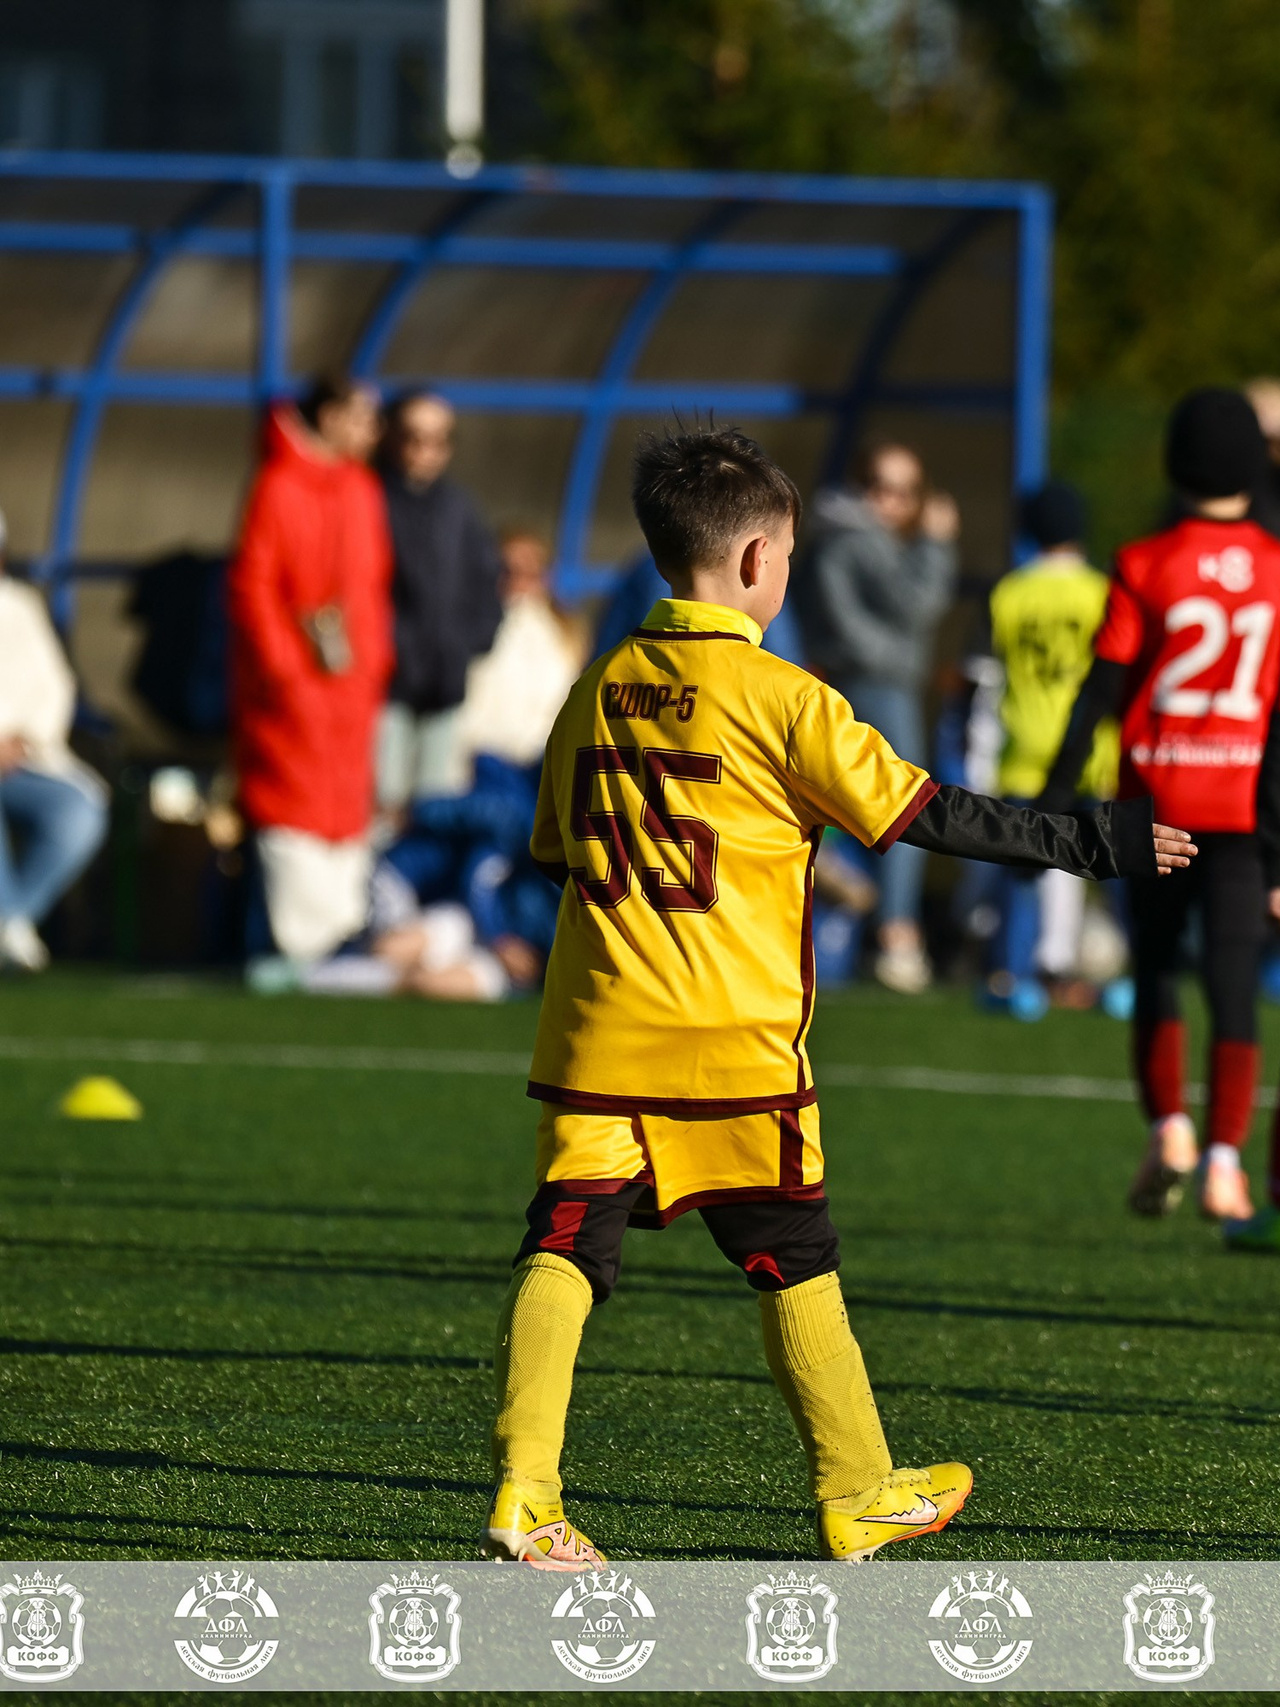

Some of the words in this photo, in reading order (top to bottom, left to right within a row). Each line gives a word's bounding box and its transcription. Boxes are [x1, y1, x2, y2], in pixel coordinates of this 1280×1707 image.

[604, 682, 698, 723] СШОР-5
[1152, 595, 1276, 722] 21
[569, 745, 722, 913] 55
